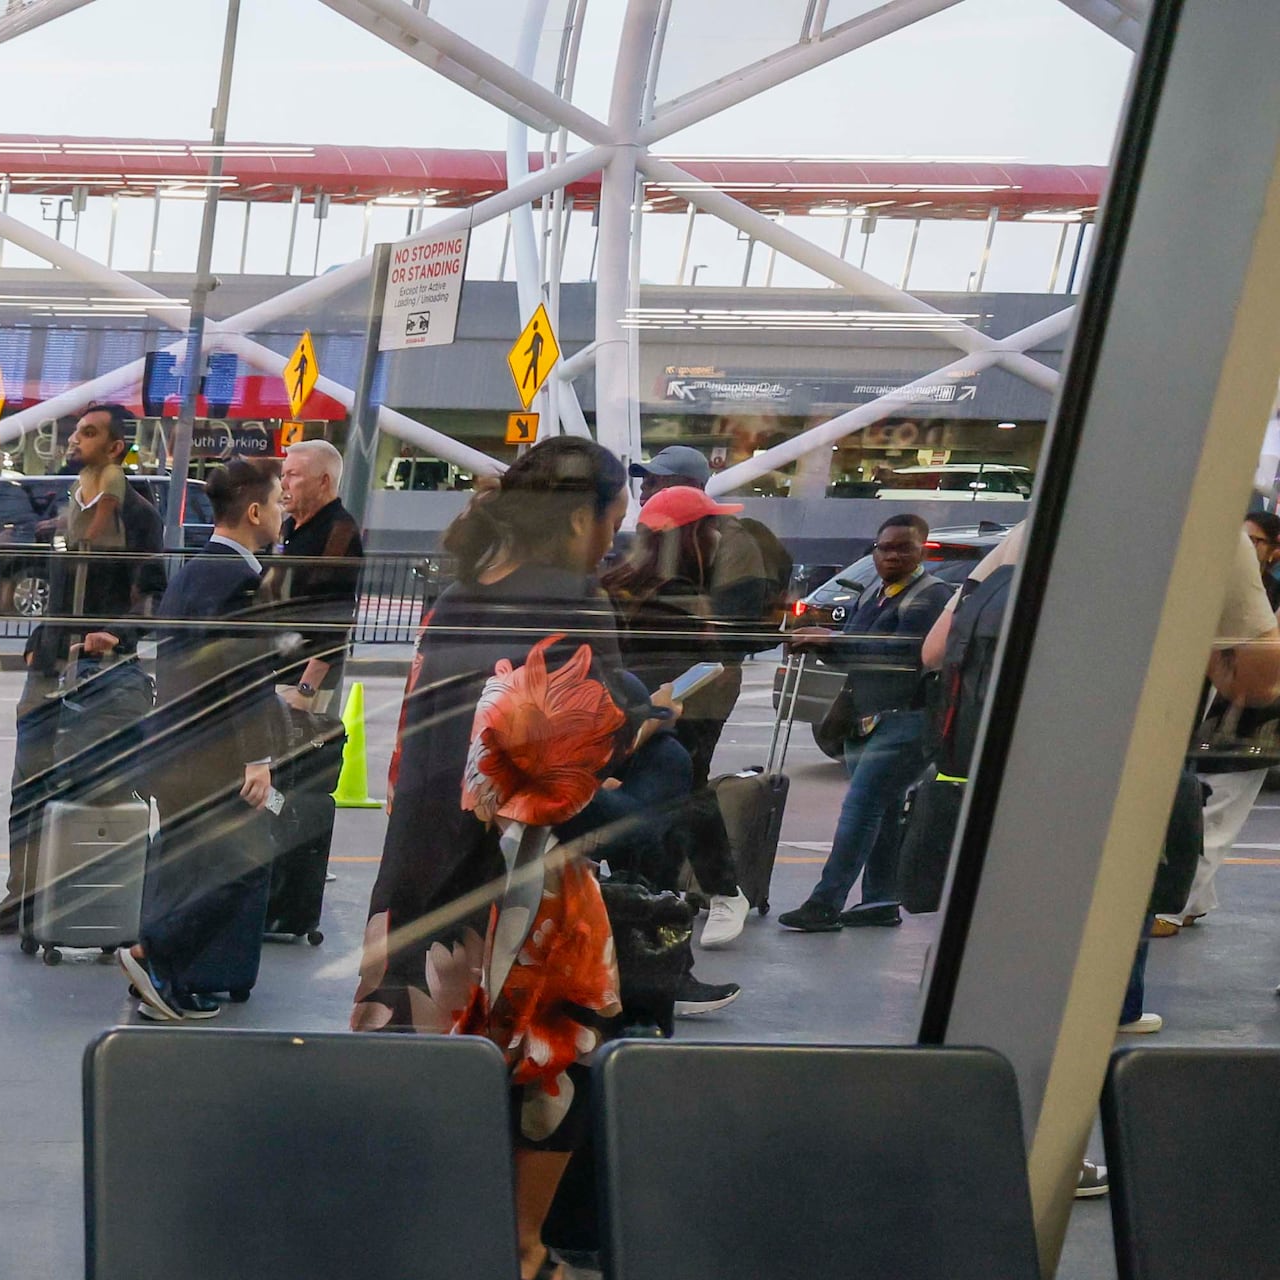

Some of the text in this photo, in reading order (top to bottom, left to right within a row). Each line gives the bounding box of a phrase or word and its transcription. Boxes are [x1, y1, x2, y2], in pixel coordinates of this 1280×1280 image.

[395, 239, 462, 265] NO STOPPING
[392, 259, 460, 284] OR STANDING
[220, 435, 268, 451] Parking
